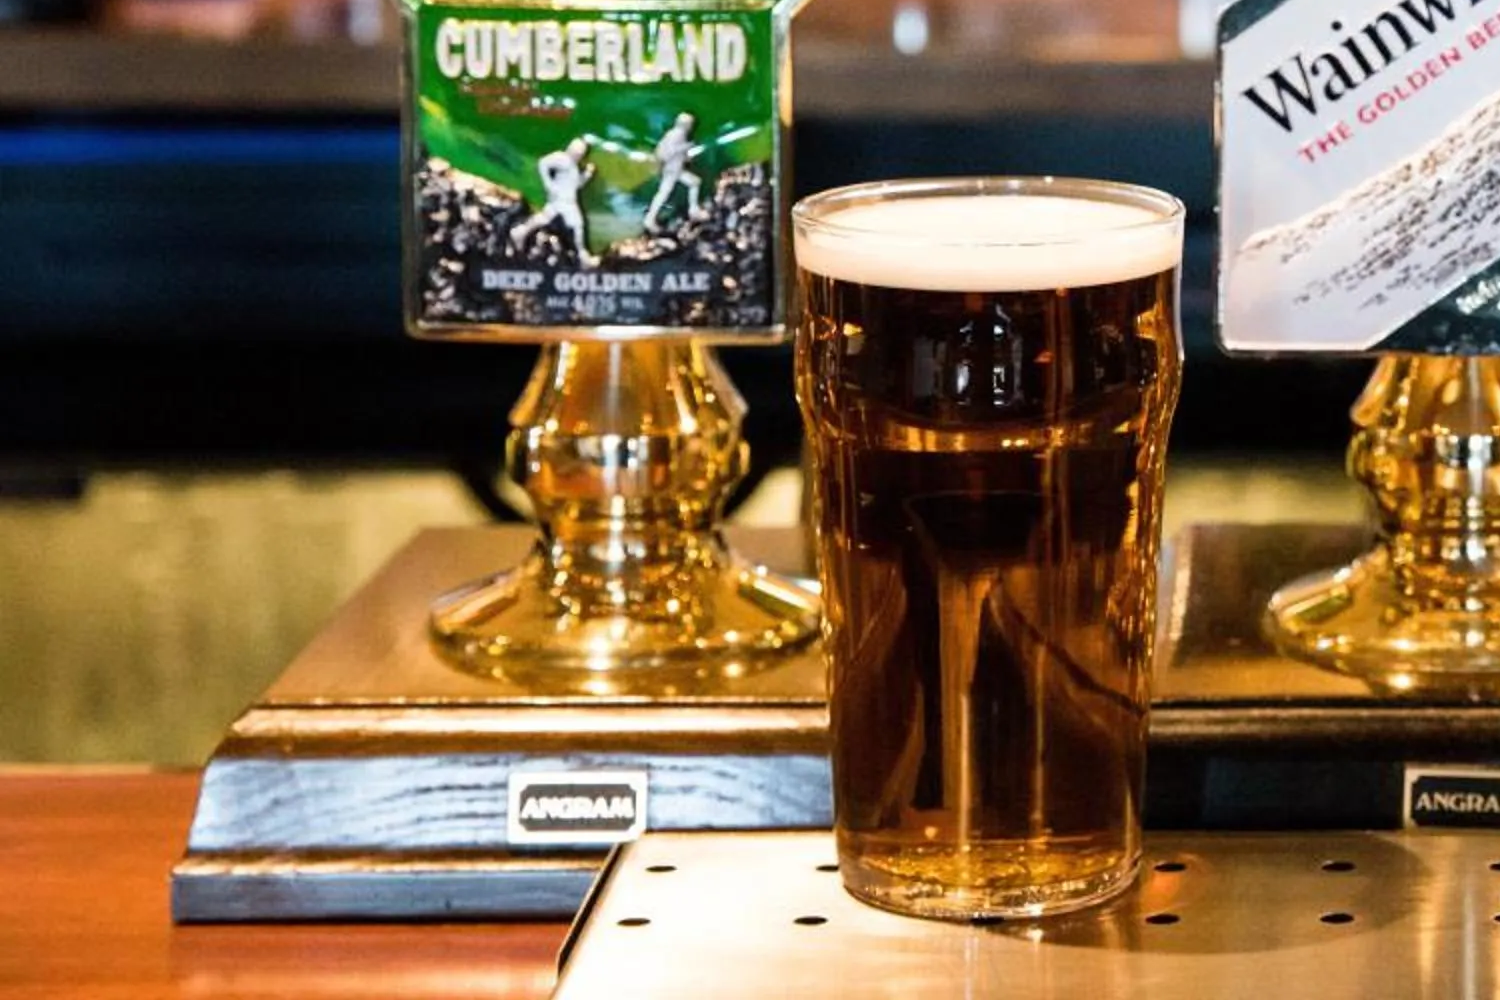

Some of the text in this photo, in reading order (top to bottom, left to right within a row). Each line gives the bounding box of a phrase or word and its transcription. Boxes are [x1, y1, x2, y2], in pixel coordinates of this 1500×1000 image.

[435, 17, 747, 83] CUMBERLAND
[1297, 121, 1355, 165] THE
[1358, 47, 1463, 127] GOLDEN
[482, 270, 711, 292] DEEP GOLDEN ALE
[520, 795, 636, 820] ANGRAM
